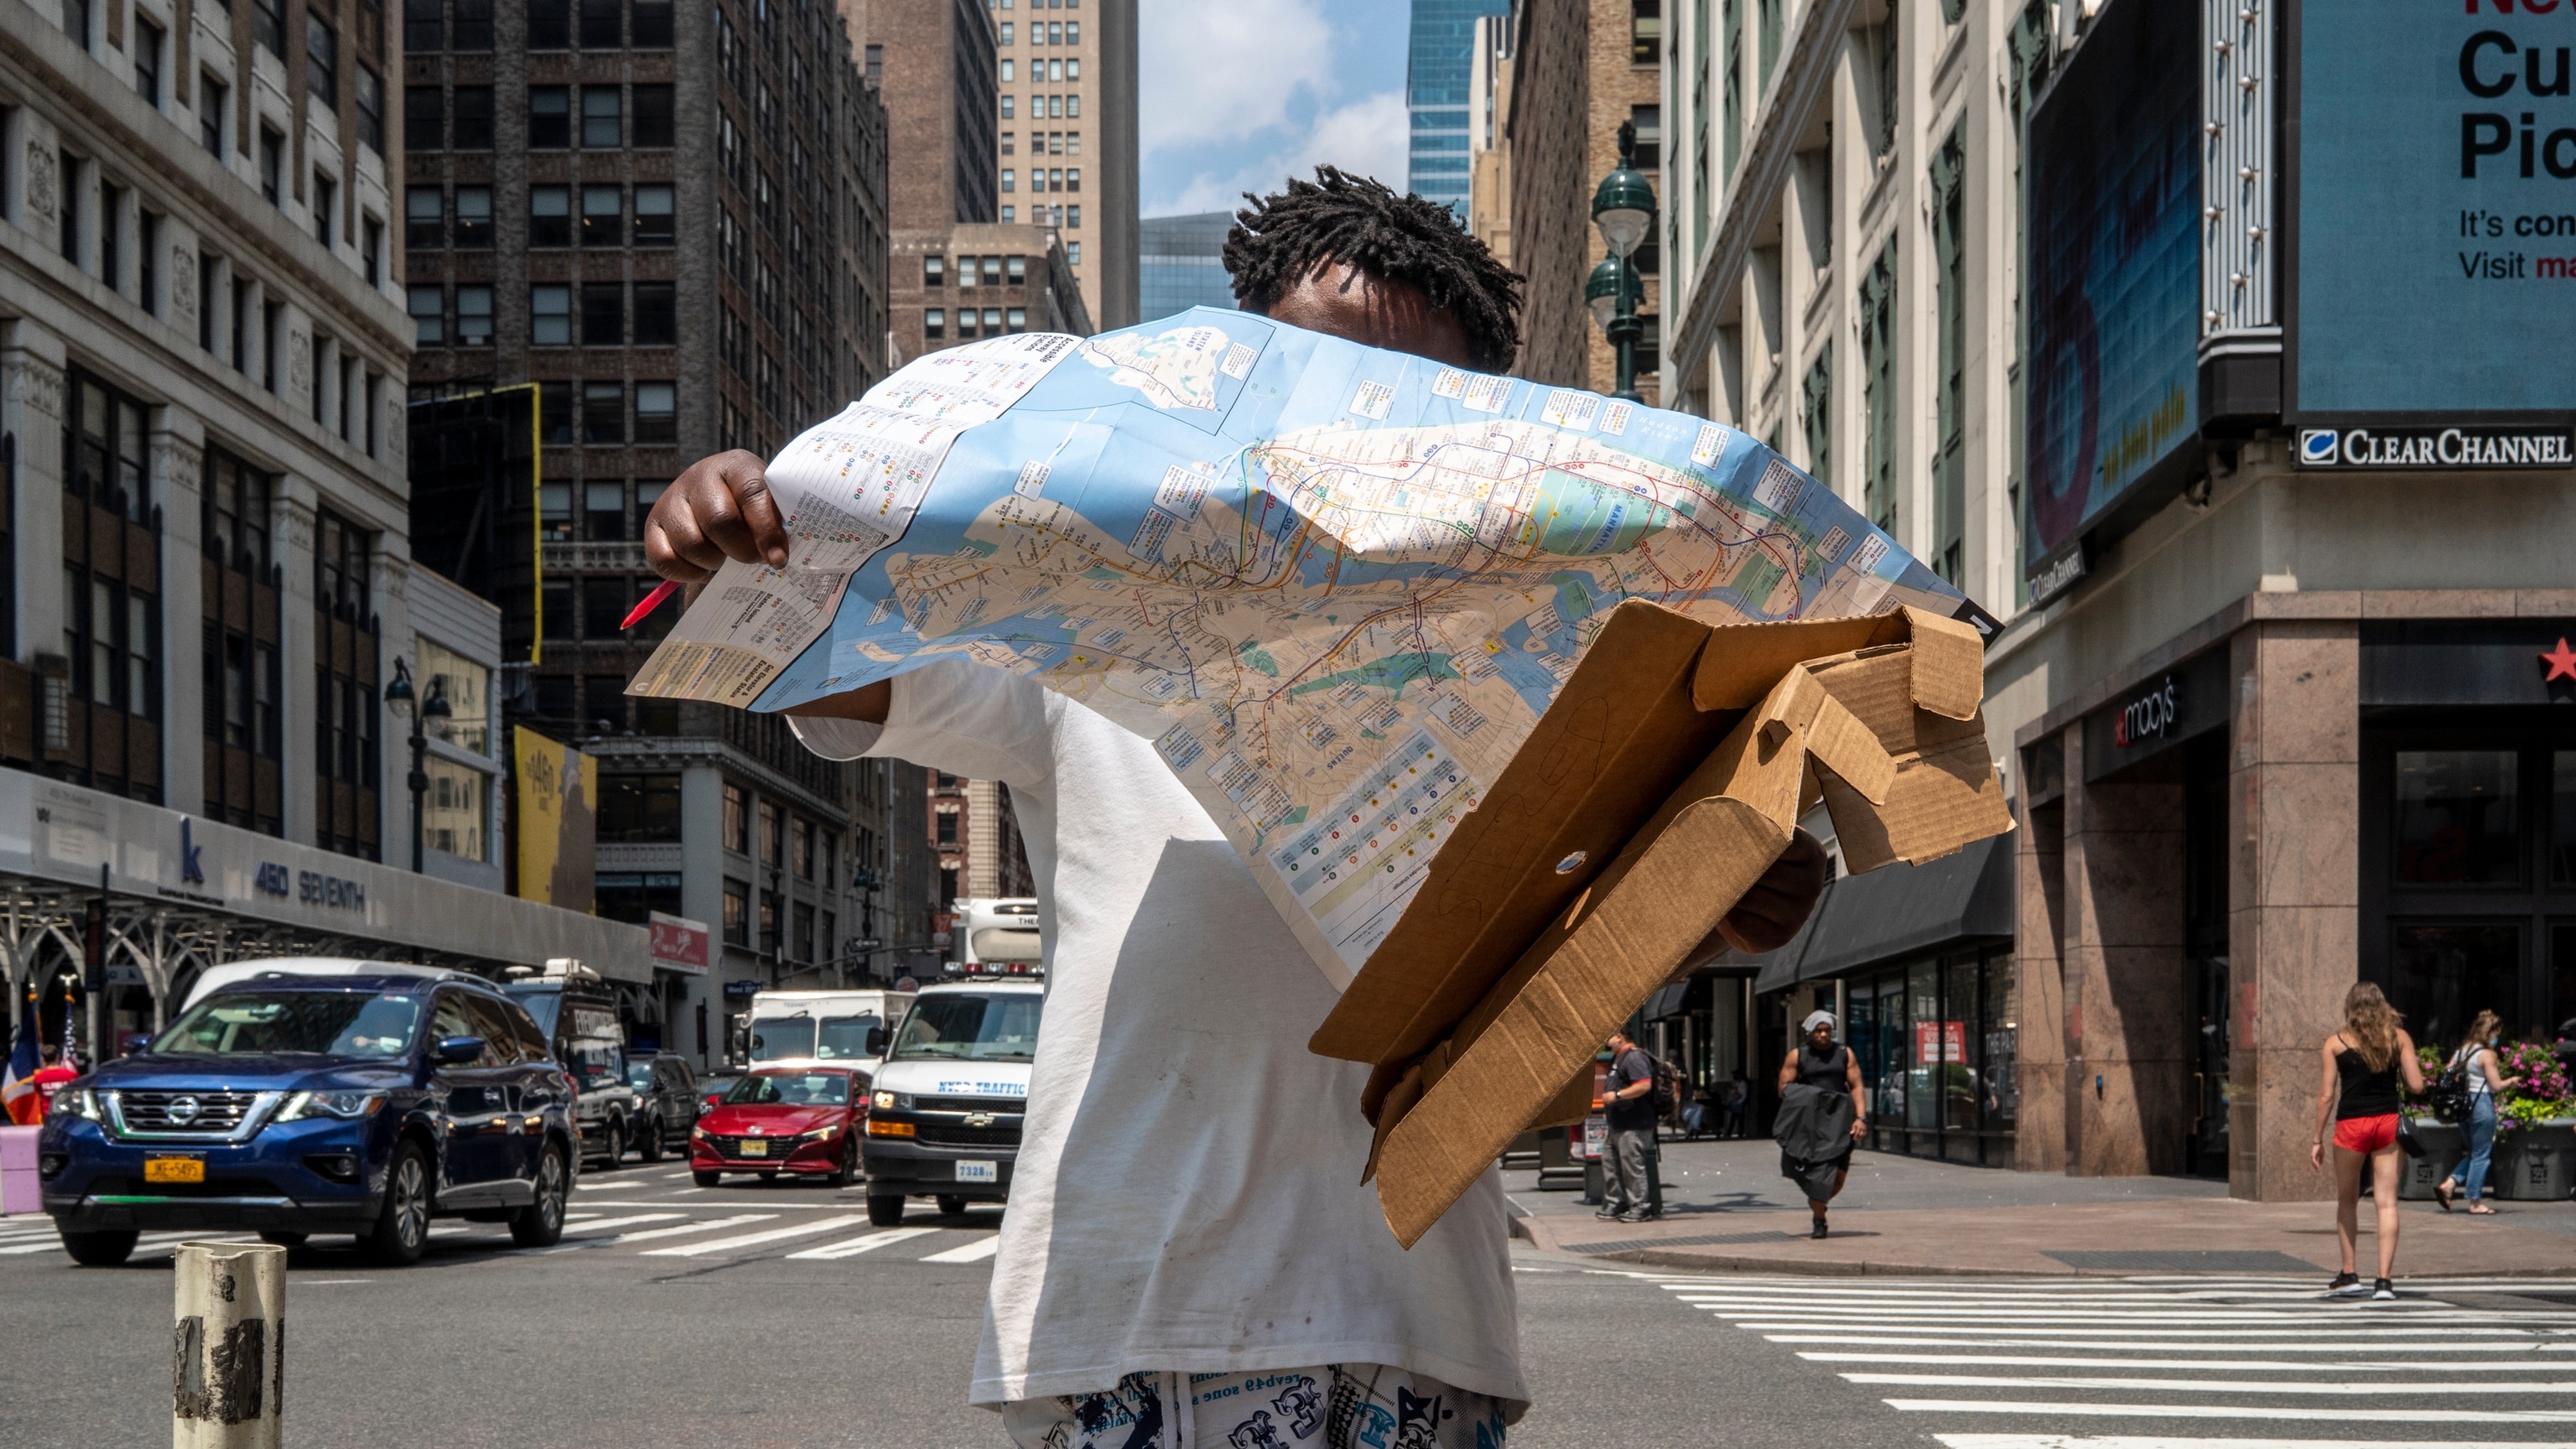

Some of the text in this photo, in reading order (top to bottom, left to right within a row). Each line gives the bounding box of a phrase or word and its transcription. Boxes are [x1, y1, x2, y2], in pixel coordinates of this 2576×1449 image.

[2459, 29, 2570, 98] Cu
[2461, 112, 2576, 179] Pic
[2459, 252, 2526, 278] Visit
[1024, 335, 1052, 351] Stations
[1036, 335, 1064, 352] Subway
[1186, 330, 1202, 348] ISLAND
[1195, 331, 1212, 351] STATEN
[1040, 337, 1074, 362] Accessible
[1639, 416, 1688, 436] Hudson
[1641, 426, 1681, 442] River
[745, 593, 773, 623] Staten Island
[744, 660, 766, 683] Escalator
[730, 682, 747, 698] Status
[746, 673, 766, 693] Elevator
[1326, 745, 1354, 771] QUEENS
[180, 817, 205, 884] k
[255, 860, 289, 897] 450
[298, 870, 366, 913] SEVENTH
[975, 1082, 1026, 1094] TRAFFIC
[959, 1166, 984, 1176] 7328
